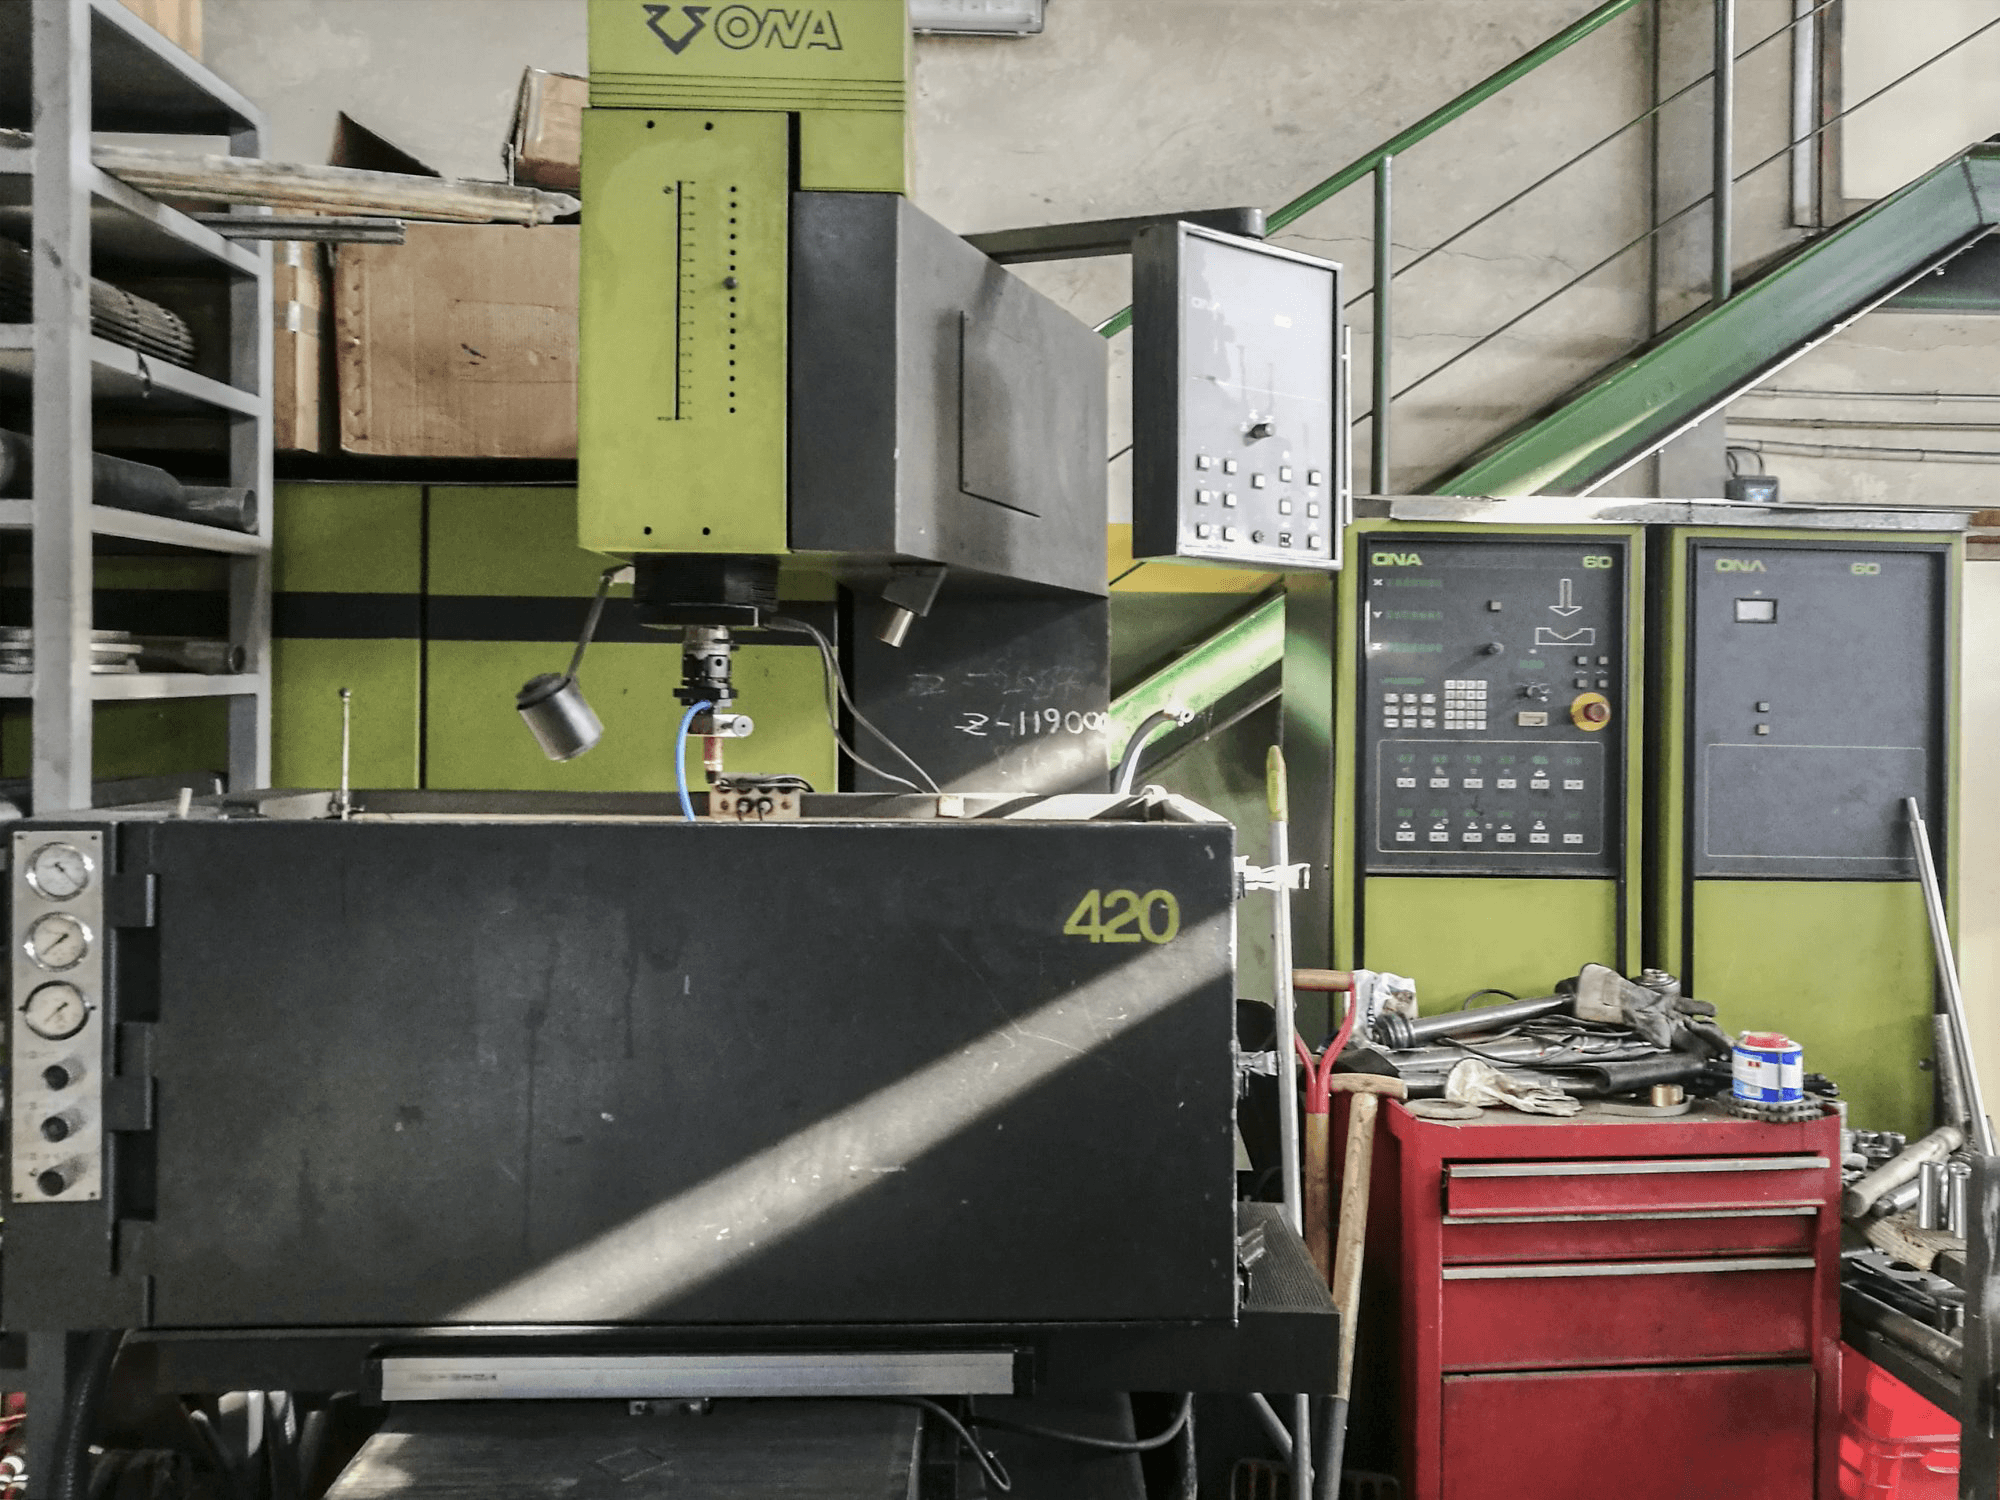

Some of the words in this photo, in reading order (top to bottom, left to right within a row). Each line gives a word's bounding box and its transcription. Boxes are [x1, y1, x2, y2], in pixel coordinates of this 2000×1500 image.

[1371, 552, 1423, 566] ONA
[1582, 555, 1613, 568] 60
[1714, 559, 1767, 572] ONA
[1063, 889, 1180, 944] 420
